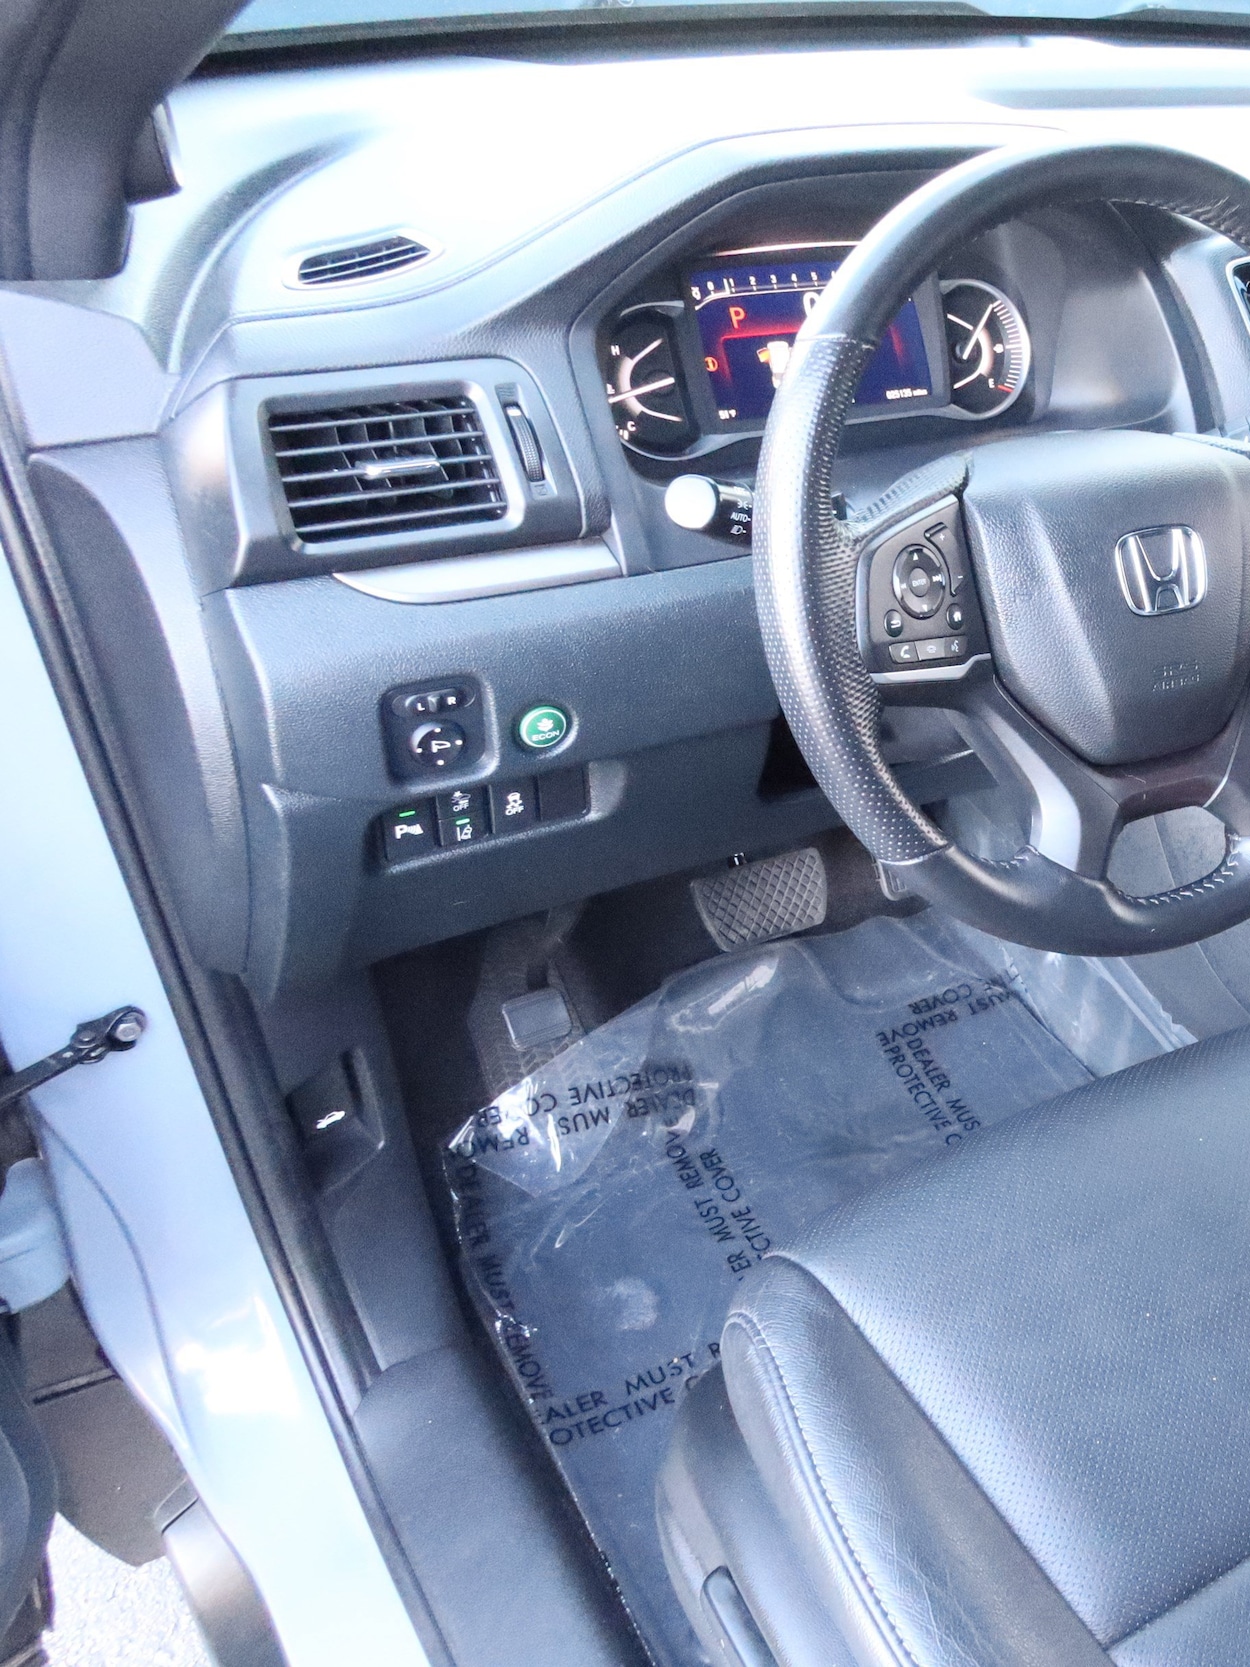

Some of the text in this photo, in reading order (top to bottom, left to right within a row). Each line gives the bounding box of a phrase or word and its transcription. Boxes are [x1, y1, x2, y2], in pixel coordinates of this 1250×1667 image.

[749, 276, 757, 286] 2
[770, 274, 778, 284] 3
[791, 273, 798, 282] 4
[811, 271, 818, 281] 5
[729, 306, 746, 329] P
[611, 345, 620, 356] H
[988, 379, 996, 389] E
[627, 421, 636, 431] C
[730, 512, 749, 523] AUTO
[417, 702, 425, 710] L
[447, 697, 456, 705] R
[531, 730, 560, 742] ECON
[453, 803, 469, 812] OFF
[505, 805, 524, 815] OFF
[908, 983, 972, 1015] COVER
[876, 1007, 958, 1047] REMOVE
[884, 1045, 952, 1132] PROTECTIVE
[907, 1037, 951, 1092] DEALER
[946, 1098, 981, 1132] MUS
[556, 1107, 611, 1136] MUS
[700, 1148, 741, 1203] COVER
[693, 1198, 736, 1243] MUST
[625, 1353, 694, 1396] MUST
[549, 1387, 676, 1446] OTECTIVE
